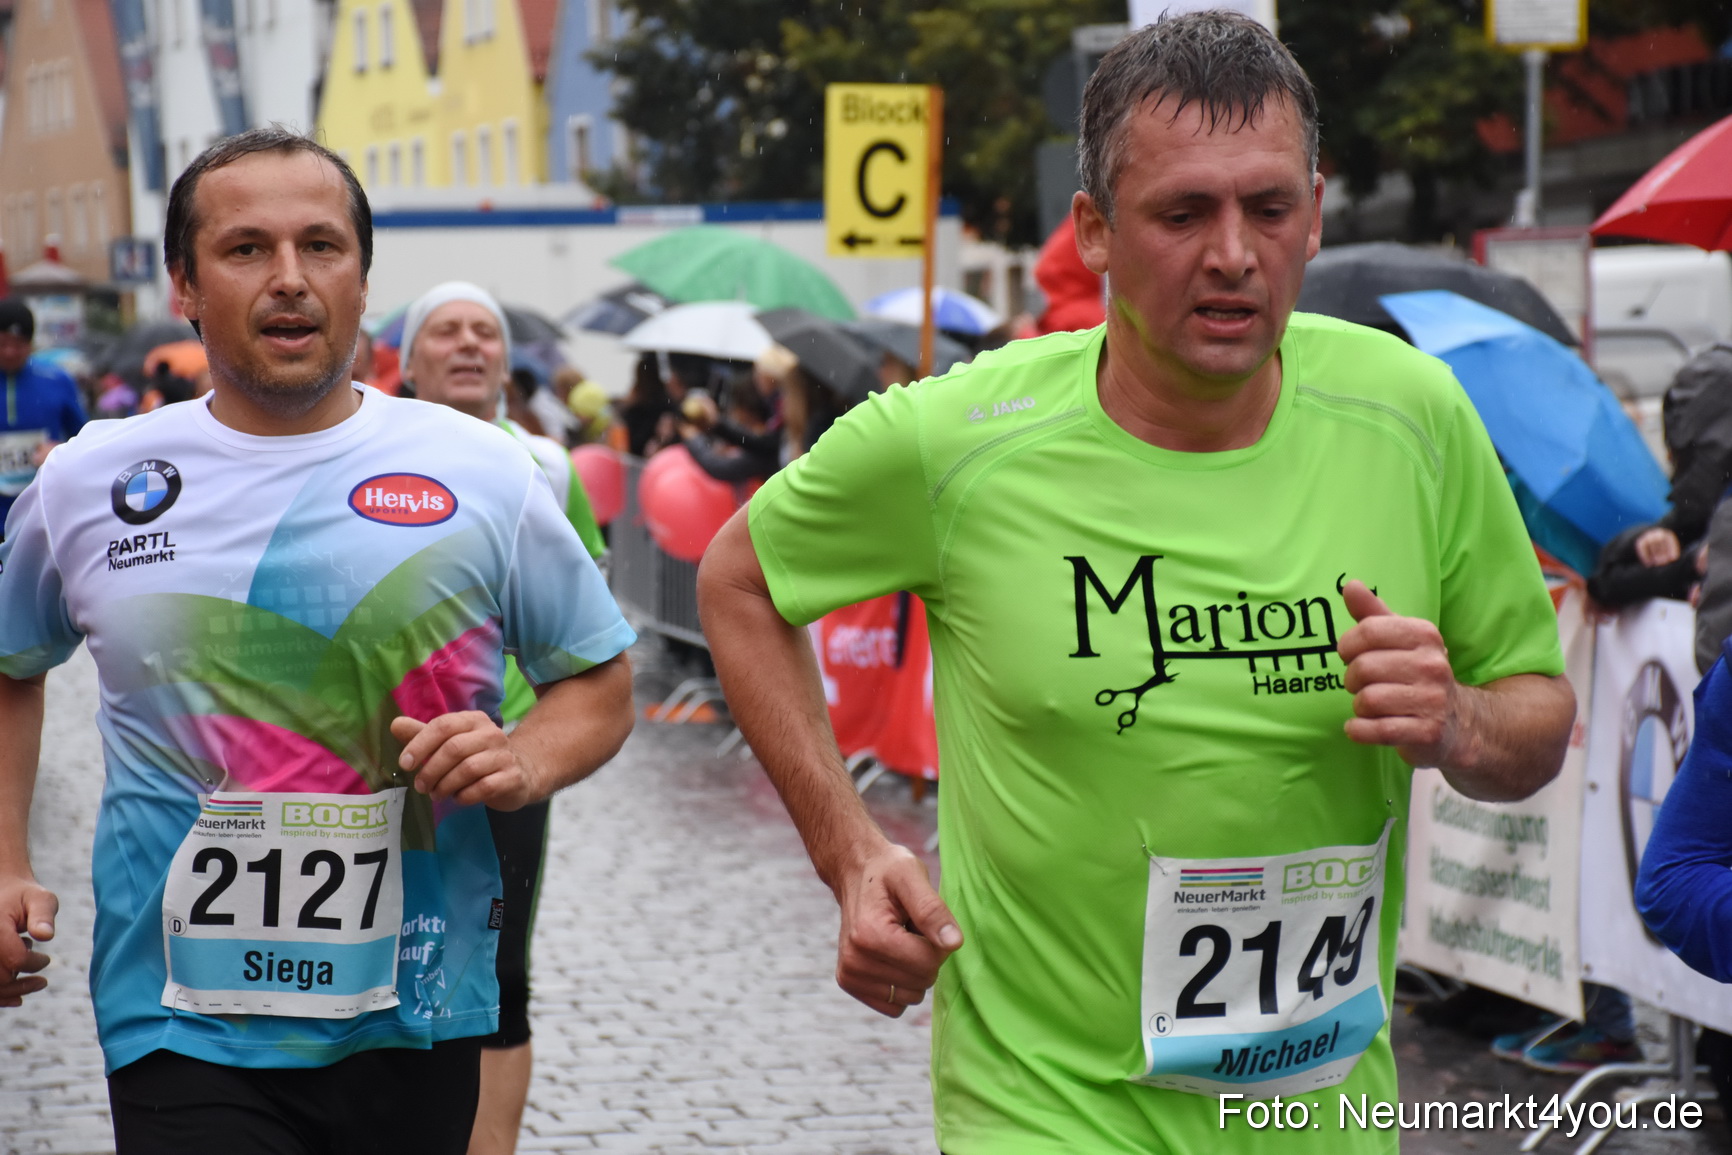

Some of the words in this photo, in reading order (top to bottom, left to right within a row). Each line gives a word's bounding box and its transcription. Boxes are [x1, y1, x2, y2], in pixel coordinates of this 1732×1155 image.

[841, 92, 927, 125] Block
[857, 140, 907, 221] C
[992, 396, 1036, 417] JAKO
[118, 461, 177, 483] BMW
[365, 488, 445, 513] Hervis
[107, 532, 176, 558] PARTL
[108, 550, 175, 572] Neumarkt
[1063, 555, 1378, 657] Marion'
[1253, 672, 1346, 695] Haarstu
[281, 800, 388, 829] BOCK
[280, 828, 318, 838] inspired
[320, 829, 332, 839] by
[333, 831, 360, 840] smart
[189, 847, 389, 931] 2127
[1173, 889, 1266, 904] NeuerMarkt
[1281, 891, 1318, 905] inspired
[1321, 890, 1334, 900] by
[172, 919, 182, 934] D
[400, 941, 436, 965] auf
[1175, 896, 1375, 1020] 2149
[243, 950, 333, 991] Siega
[1156, 1015, 1167, 1034] C
[1213, 1021, 1340, 1077] Michael
